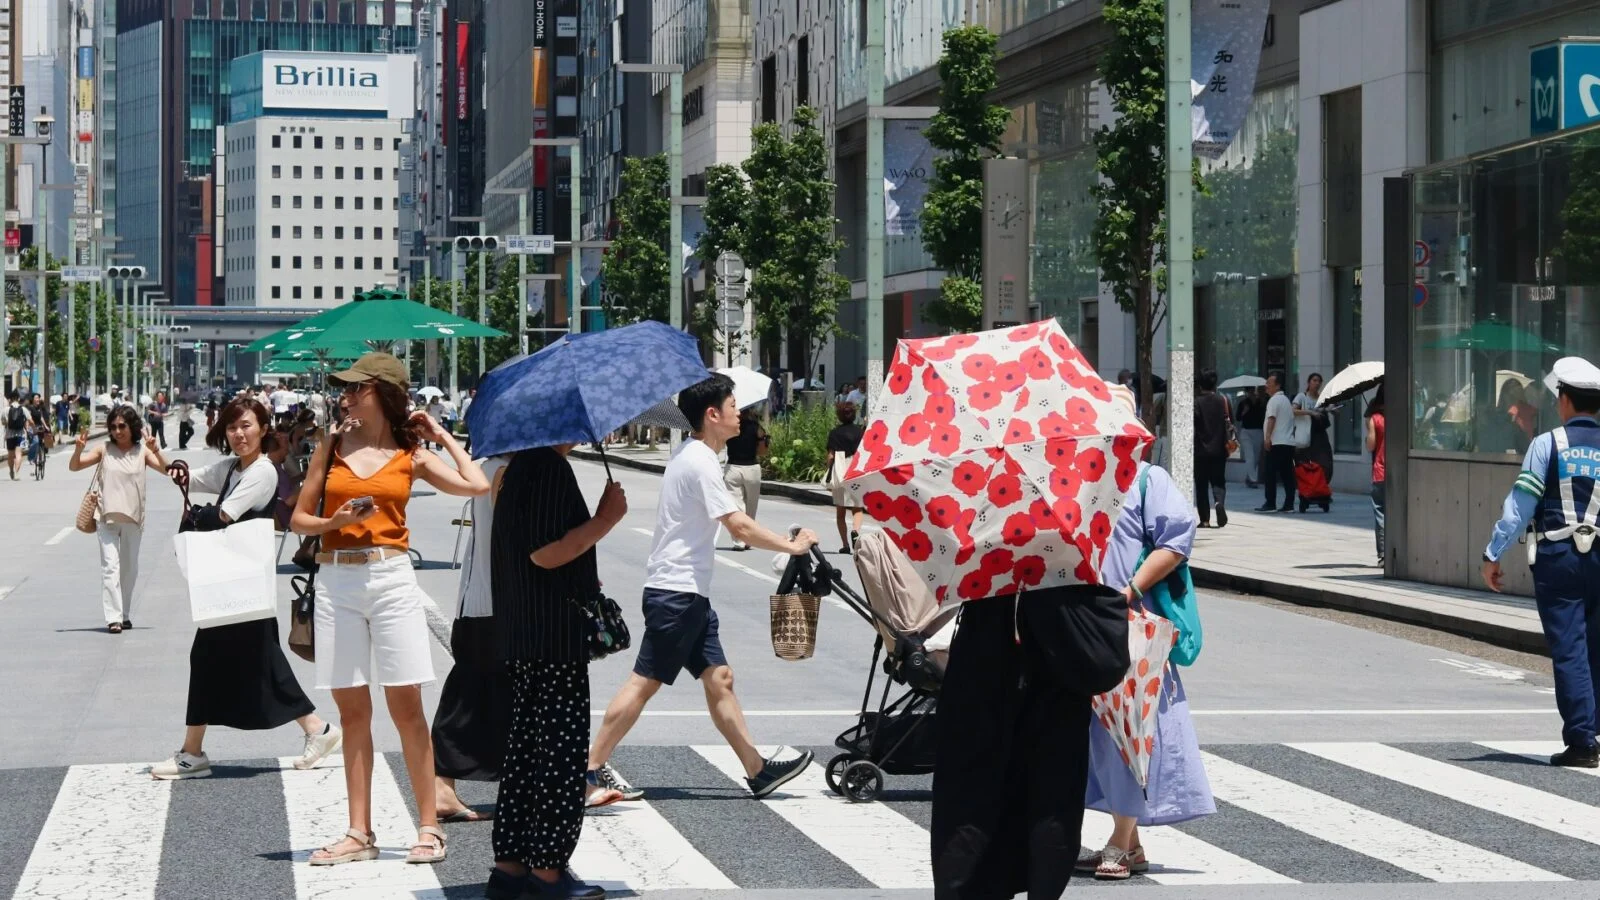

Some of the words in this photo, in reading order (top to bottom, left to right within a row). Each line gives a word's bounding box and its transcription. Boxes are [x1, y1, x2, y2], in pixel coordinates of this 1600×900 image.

[274, 65, 379, 87] Brillia
[1211, 50, 1234, 93] 和光
[509, 240, 551, 248] 銀座二丁目
